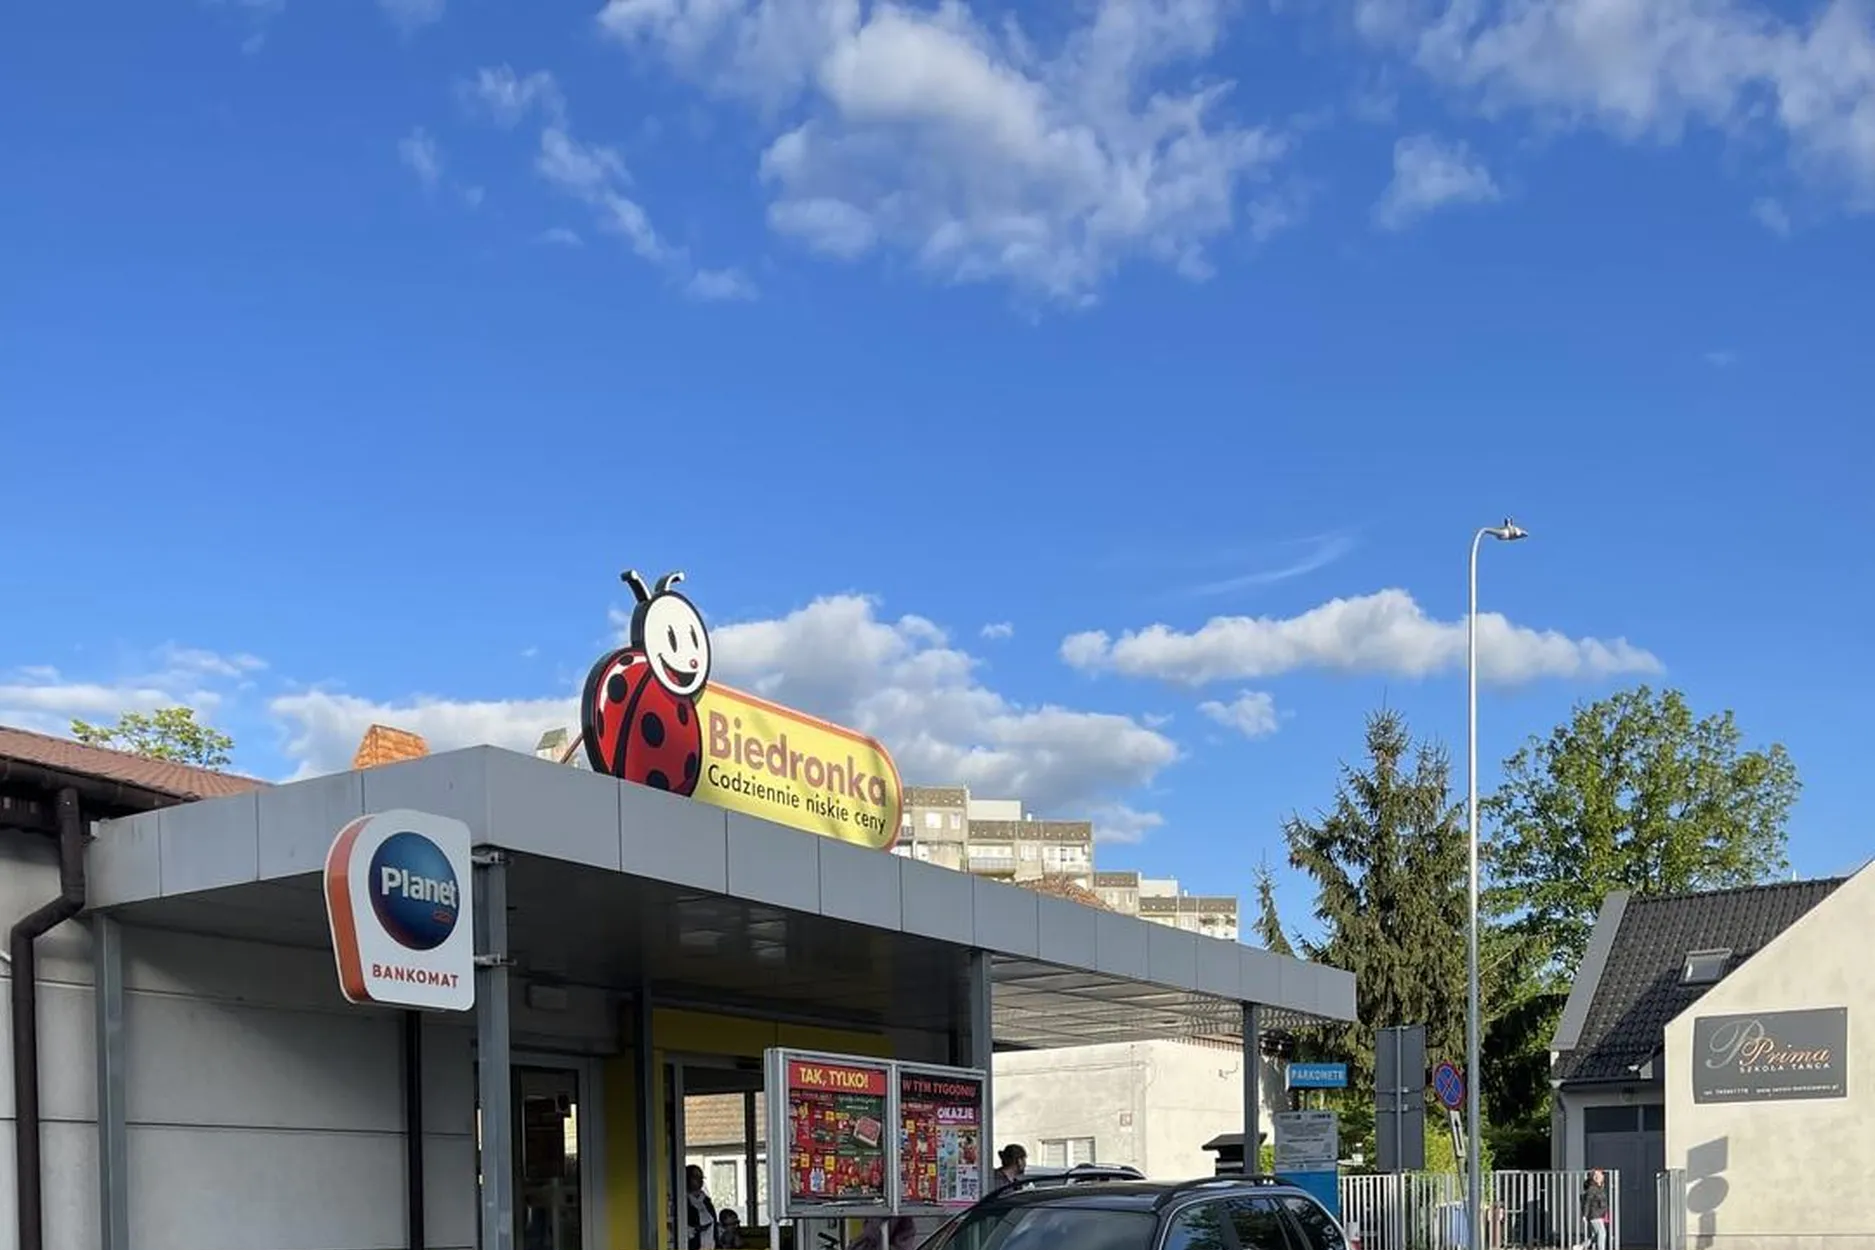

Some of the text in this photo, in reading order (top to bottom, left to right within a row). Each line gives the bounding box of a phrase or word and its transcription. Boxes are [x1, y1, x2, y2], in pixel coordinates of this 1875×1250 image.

[709, 711, 887, 807] Biedronka
[708, 764, 886, 834] Codziennie niskie ceny
[381, 866, 457, 908] Planet
[372, 964, 459, 988] BANKOMAT
[1739, 1038, 1831, 1066] Prima
[800, 1067, 868, 1088] TAK, TYLKO!
